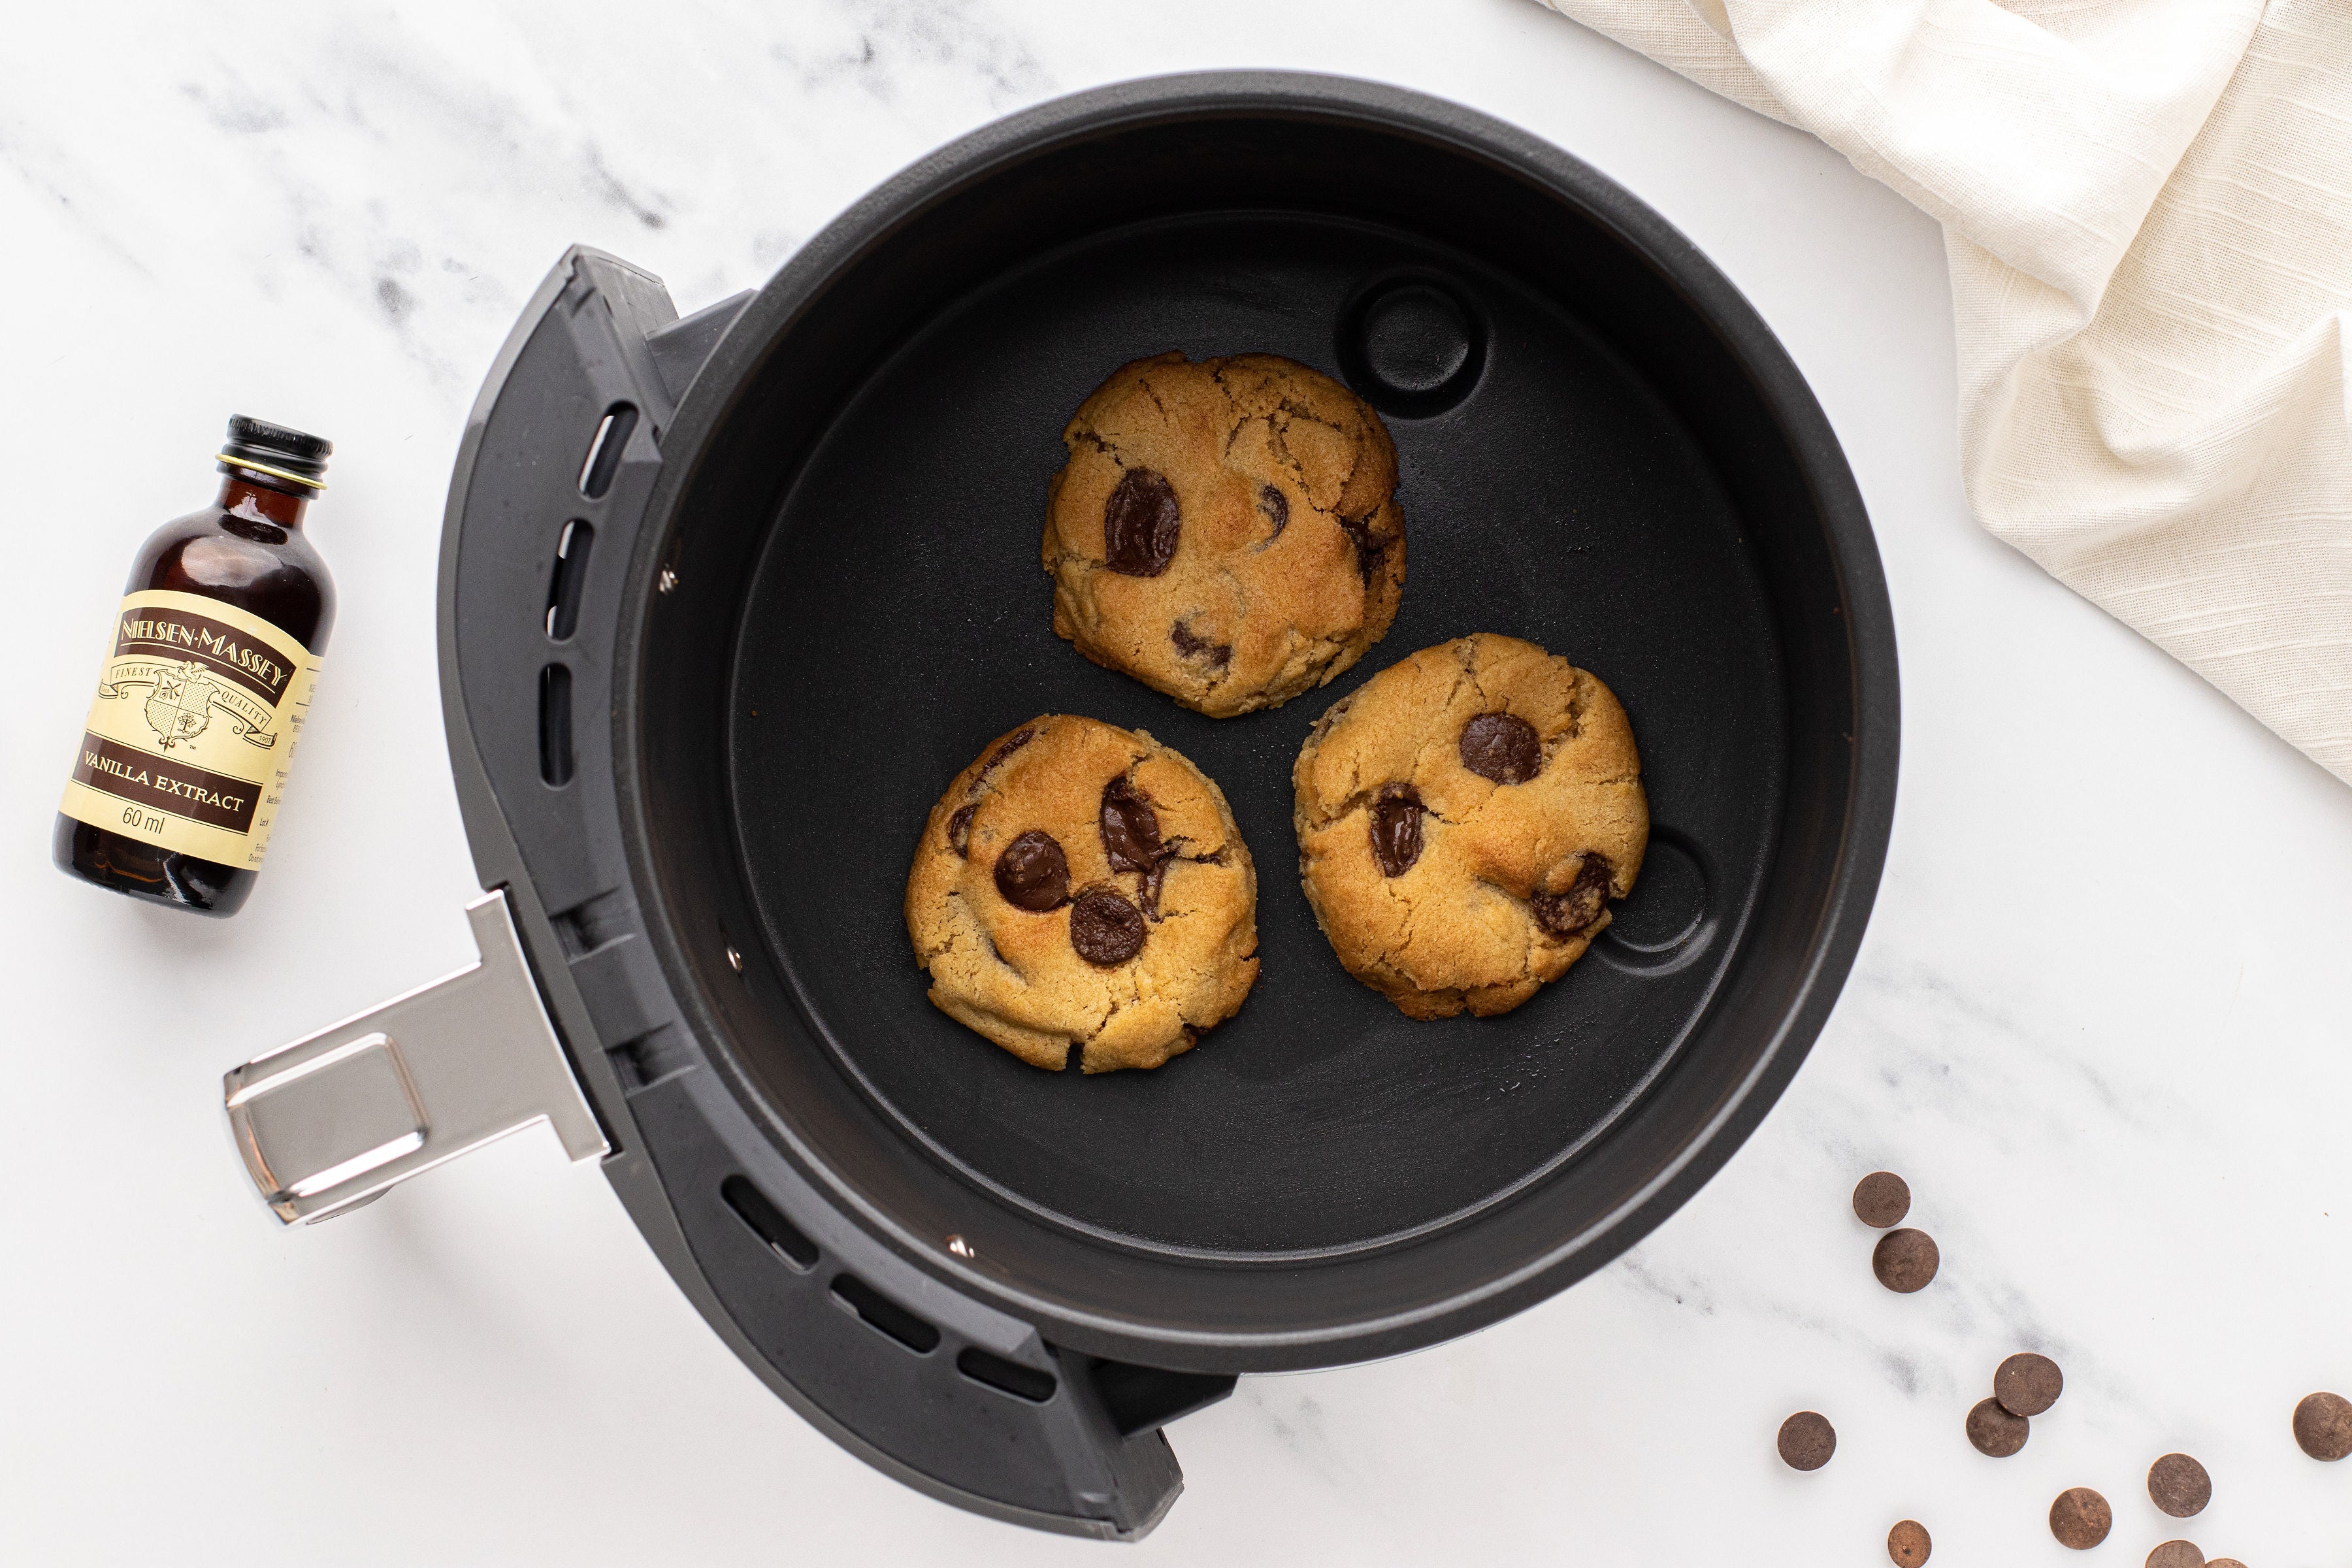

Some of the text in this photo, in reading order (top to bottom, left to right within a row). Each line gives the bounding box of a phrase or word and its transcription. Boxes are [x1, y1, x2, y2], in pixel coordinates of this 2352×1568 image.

[115, 666, 154, 679] FINEST
[221, 691, 267, 726] QUALITY
[259, 734, 272, 744] 1907
[84, 750, 244, 812] VANILLA EXTRACT
[122, 806, 166, 834] 60 ml
